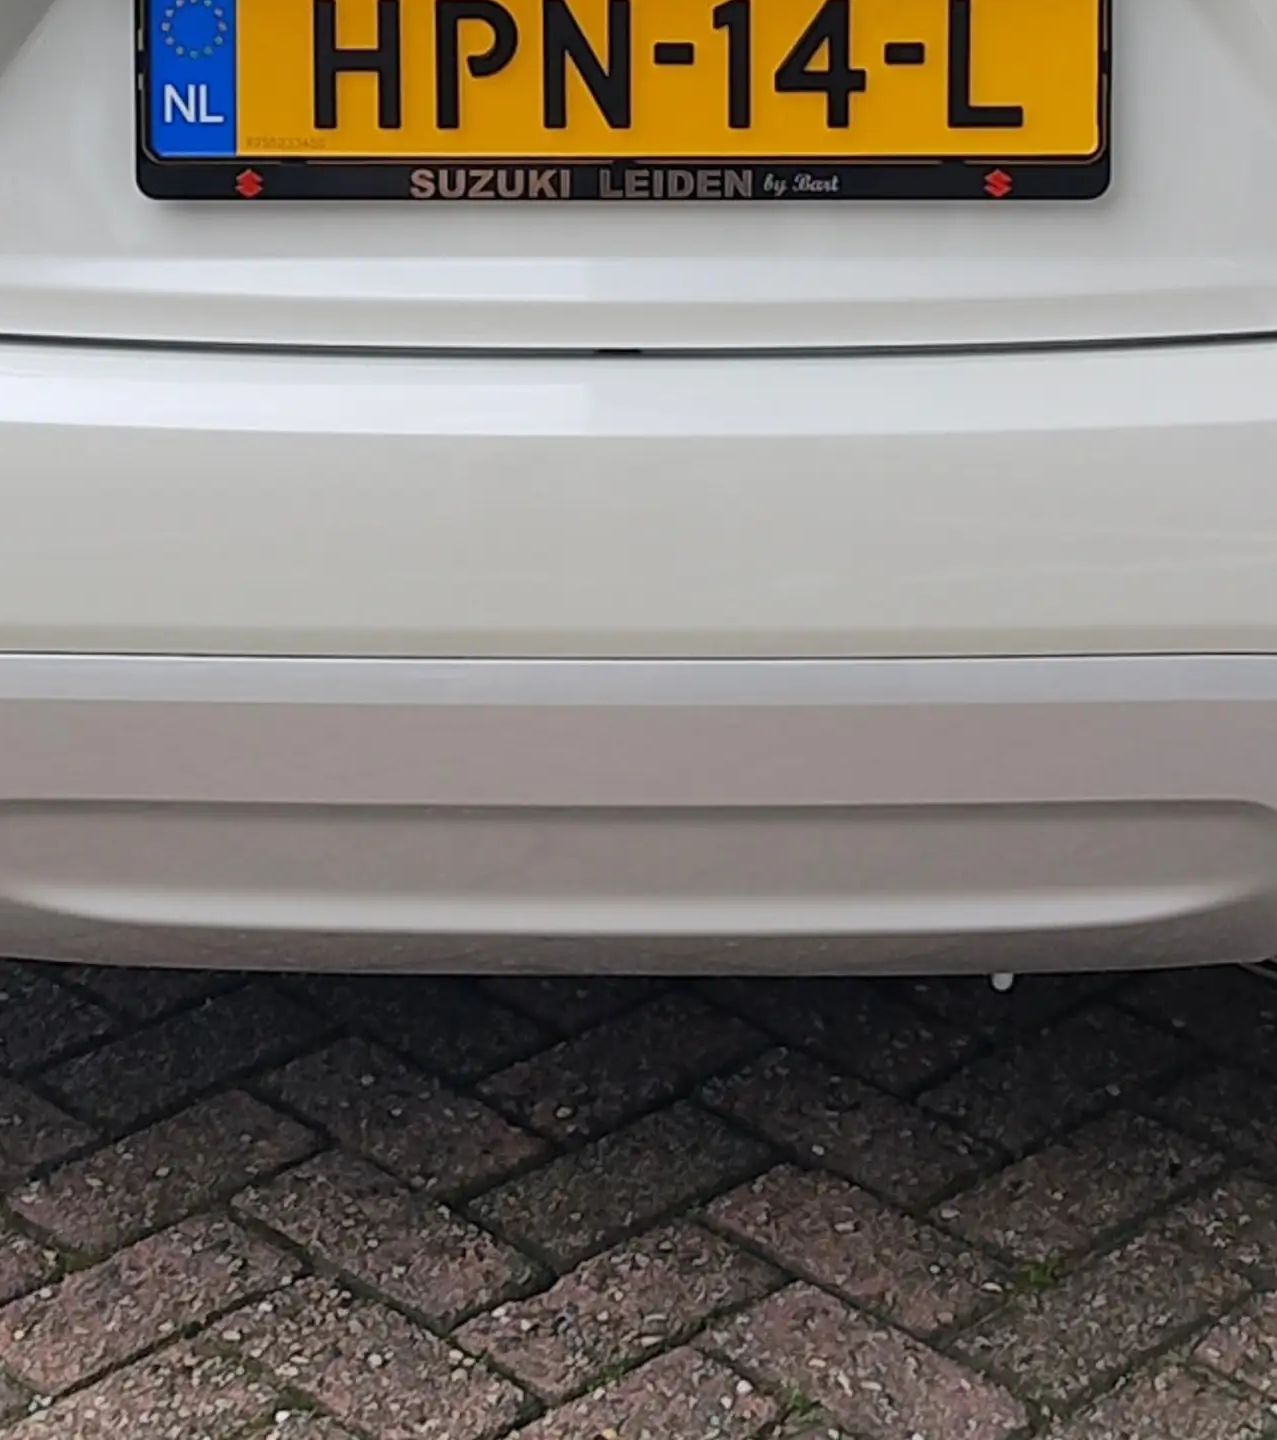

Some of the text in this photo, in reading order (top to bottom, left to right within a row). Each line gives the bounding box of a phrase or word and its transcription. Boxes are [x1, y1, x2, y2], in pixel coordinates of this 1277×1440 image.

[163, 83, 225, 124] NL
[410, 168, 840, 198] SUZUKI LEIDEN by Bart
